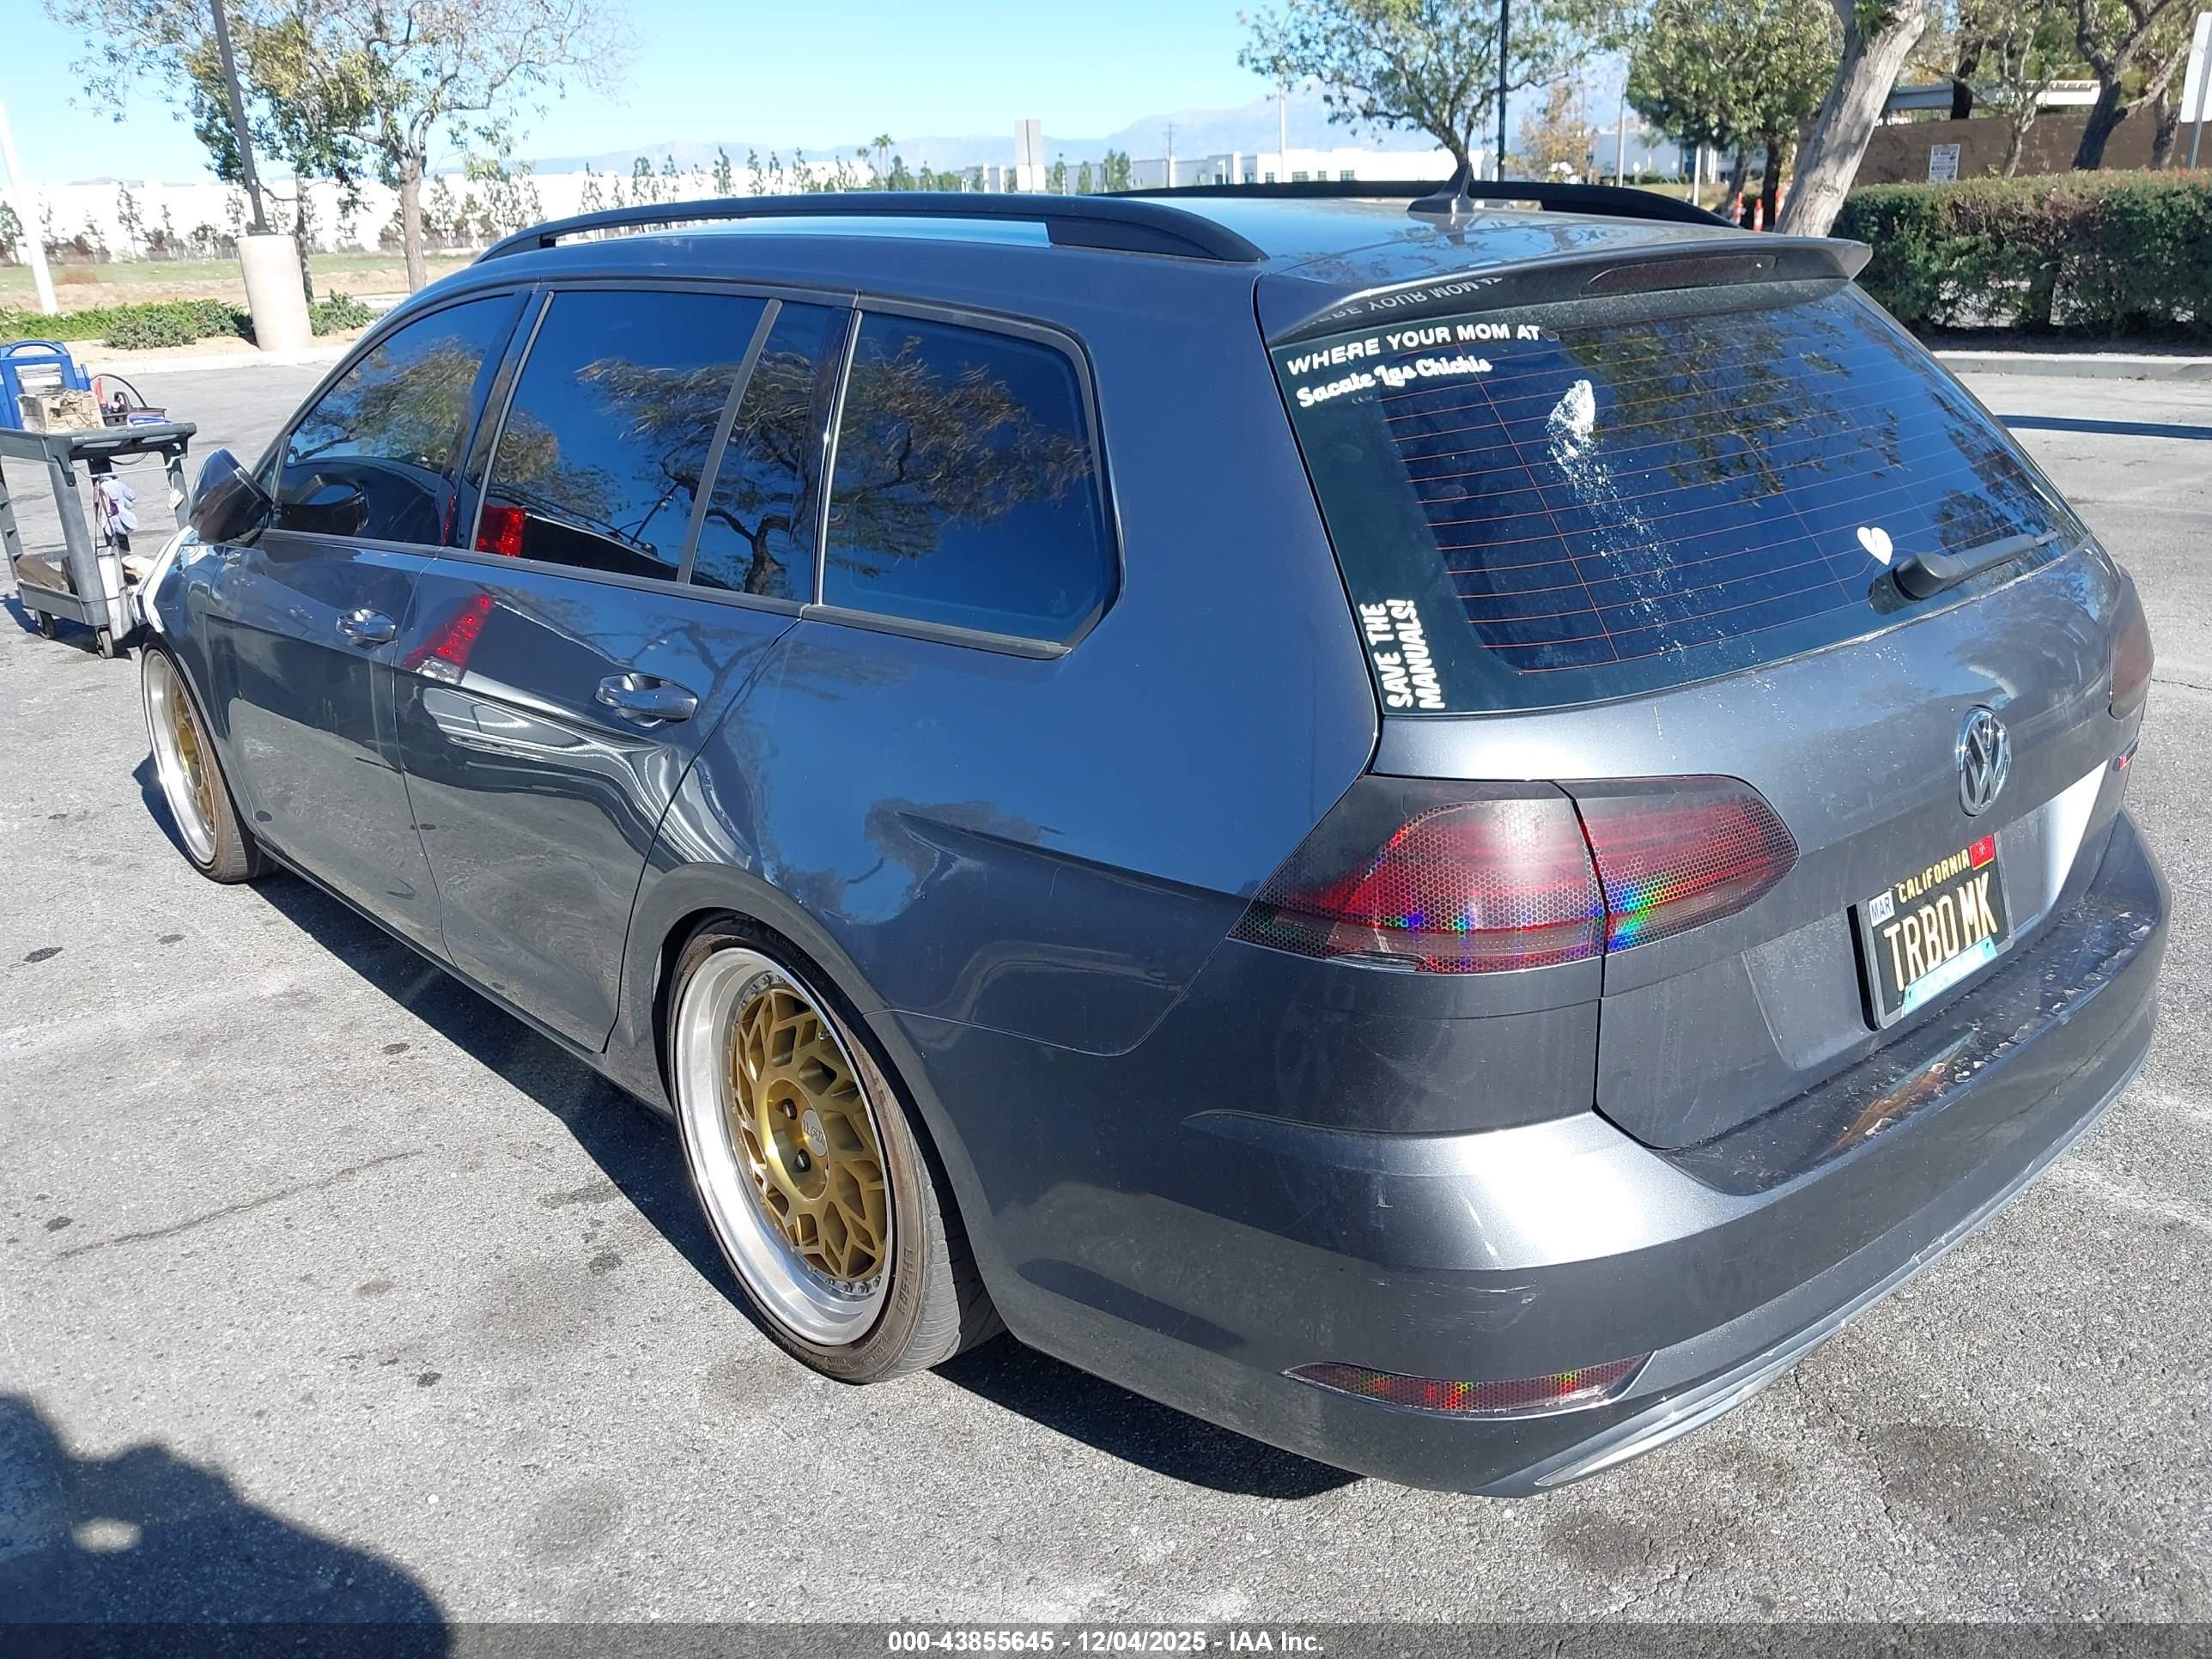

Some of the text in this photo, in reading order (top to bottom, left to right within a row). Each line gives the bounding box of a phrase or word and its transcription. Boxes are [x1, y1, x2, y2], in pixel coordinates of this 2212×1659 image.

[1287, 323, 1540, 375] WHERE YOUR MOM AT
[1296, 355, 1493, 408] Sacate Las Chichis
[1358, 603, 1414, 708] SAVE THE
[1386, 599, 1446, 709] MANUALS!
[1898, 848, 1971, 904] CALIFORNIA
[1871, 896, 1893, 923] MAR
